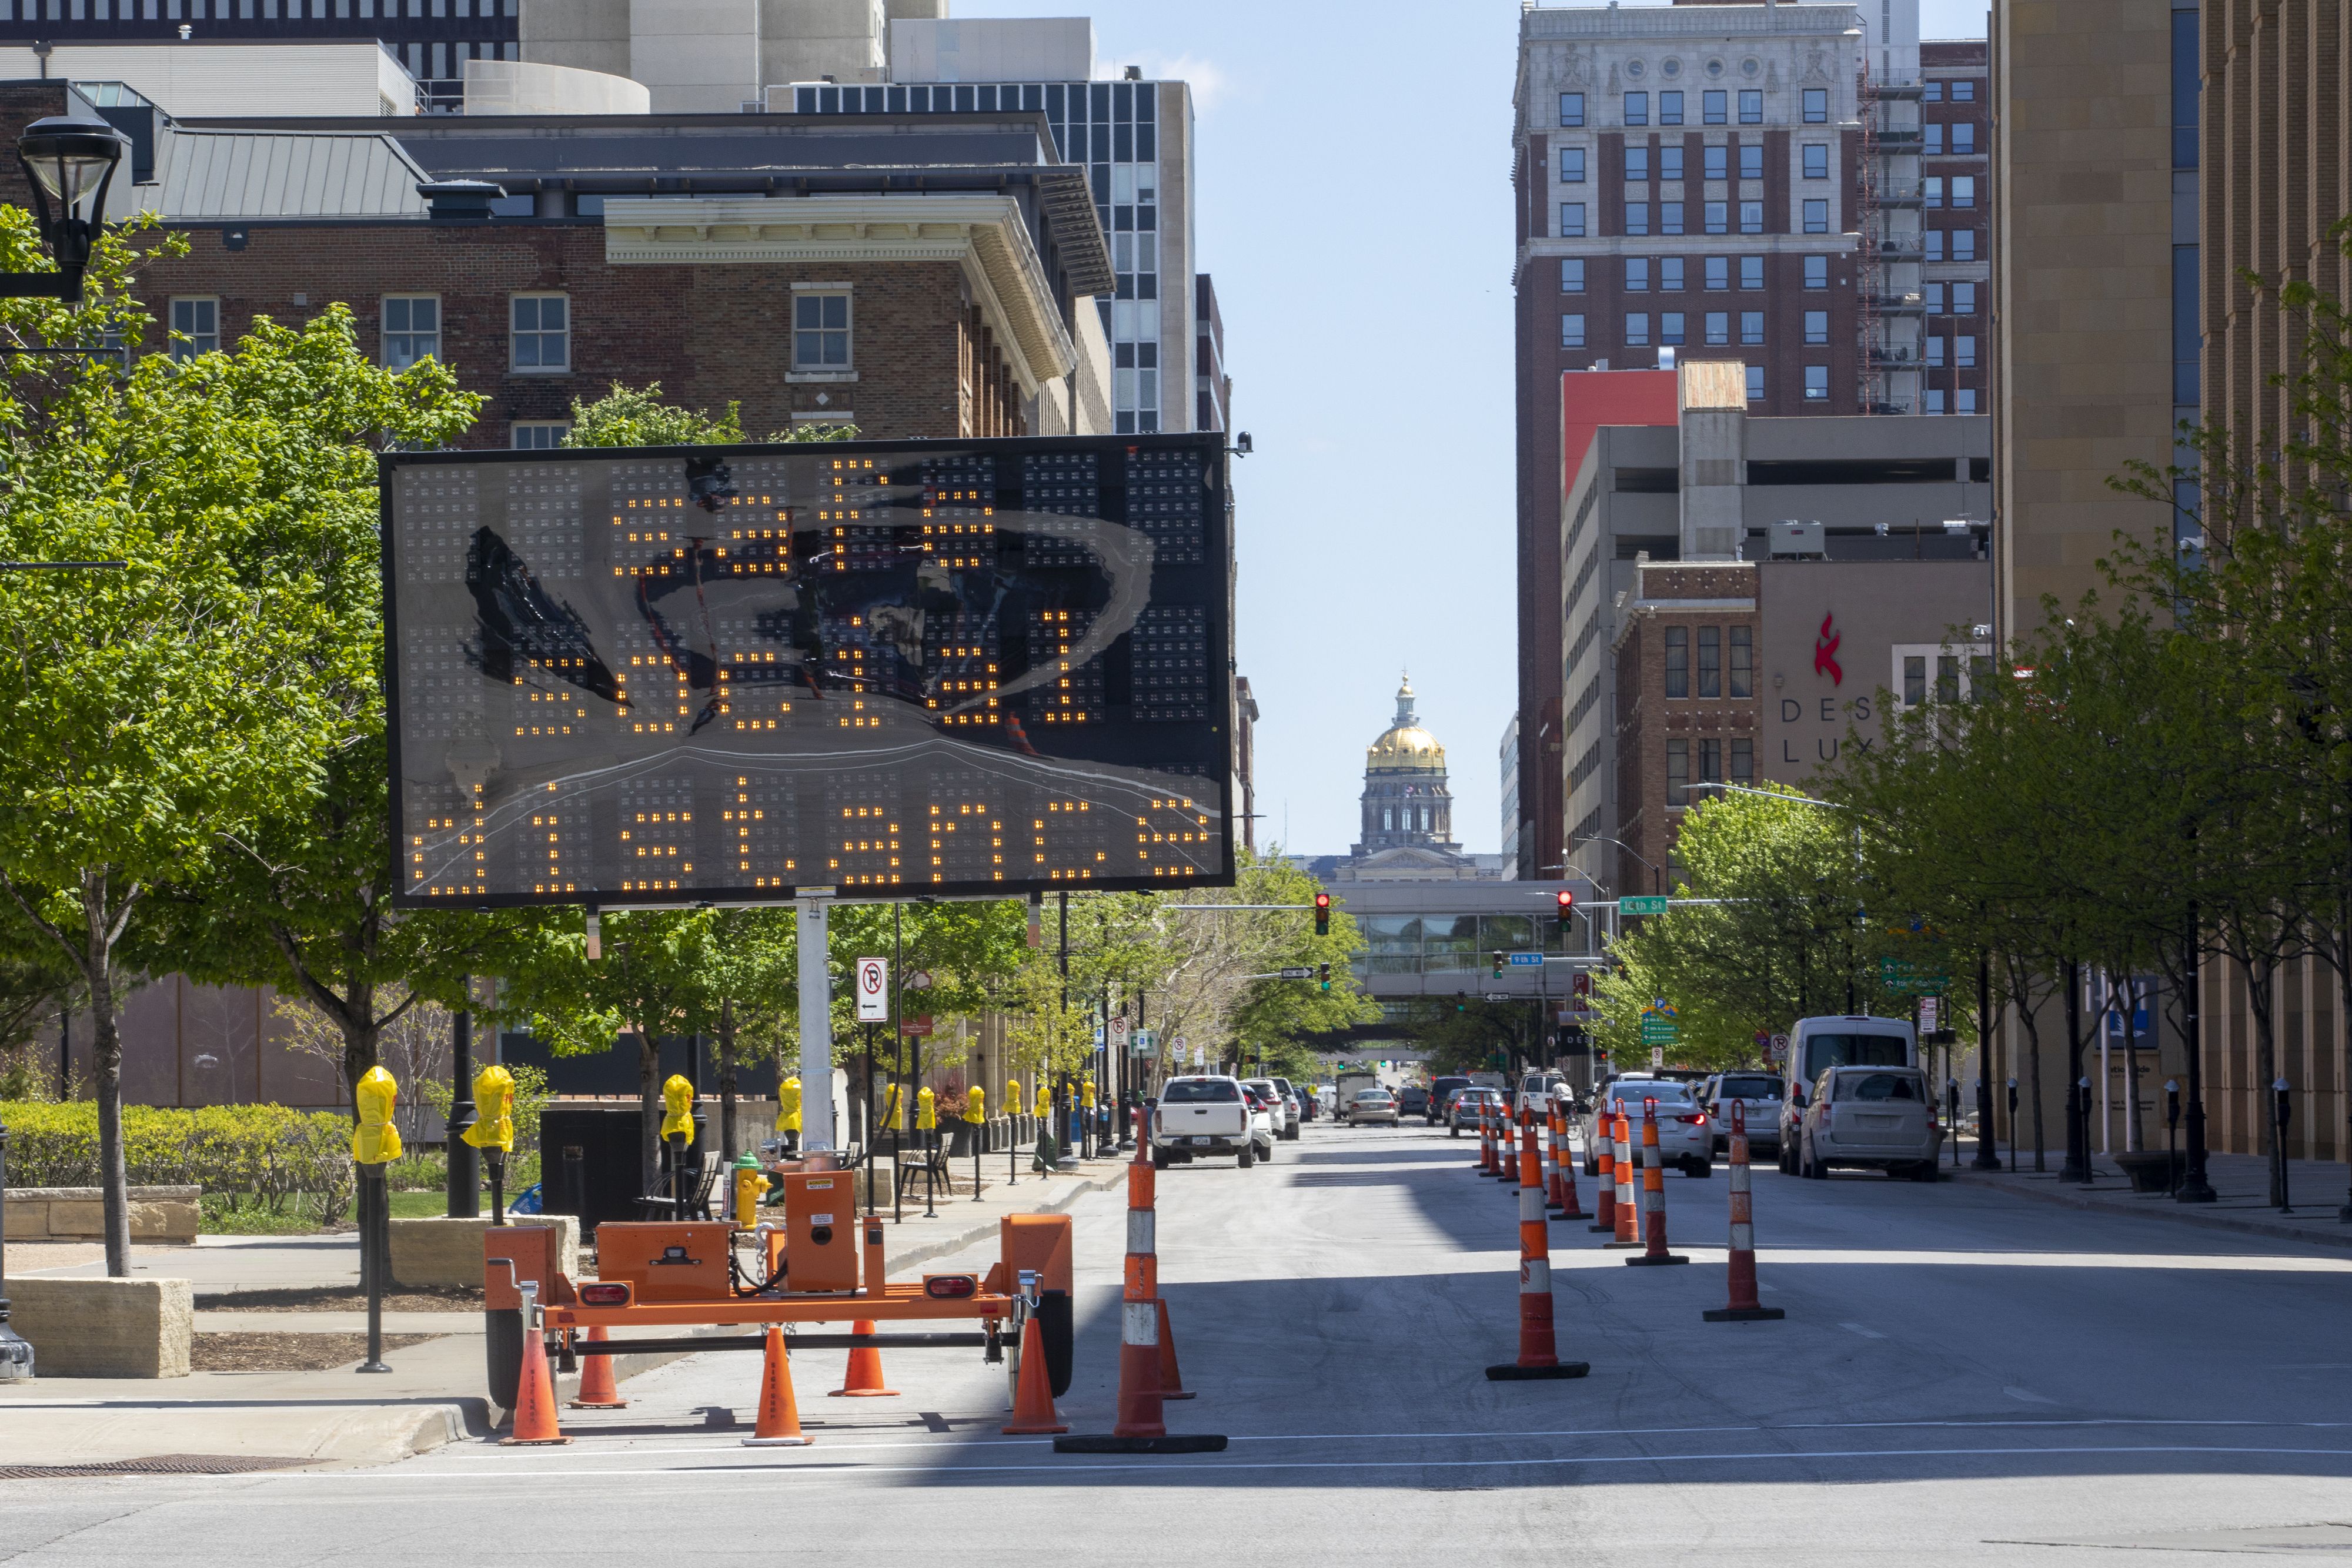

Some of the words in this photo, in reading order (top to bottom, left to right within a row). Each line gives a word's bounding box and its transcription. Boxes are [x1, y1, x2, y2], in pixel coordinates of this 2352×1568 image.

[614, 460, 993, 575] safe
[514, 612, 1085, 735] social
[1782, 696, 1871, 723] DES
[414, 777, 1208, 895] distance
[1651, 900, 1662, 910] St
